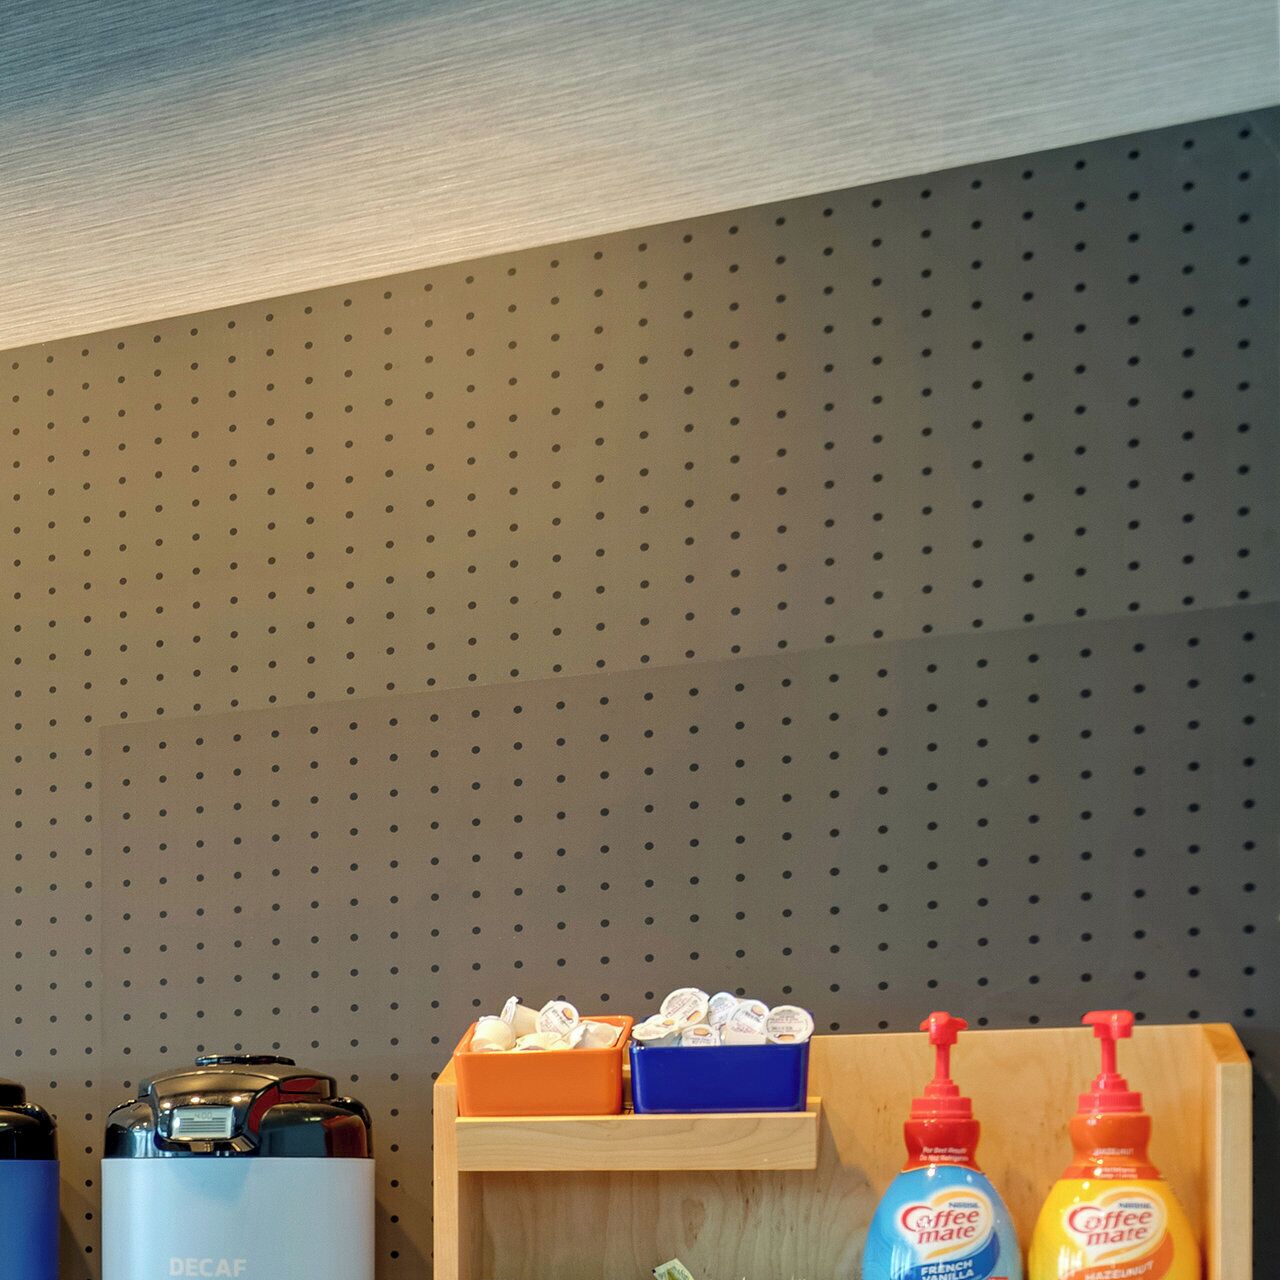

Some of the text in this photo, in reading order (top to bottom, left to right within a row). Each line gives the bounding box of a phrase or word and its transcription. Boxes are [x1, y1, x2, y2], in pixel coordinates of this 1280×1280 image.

[901, 1205, 980, 1233] Coffee
[1068, 1206, 1153, 1233] Coffee
[917, 1226, 976, 1244] mate
[1087, 1227, 1148, 1246] mate
[169, 1257, 247, 1278] DECAF
[921, 1260, 973, 1276] FRENCH
